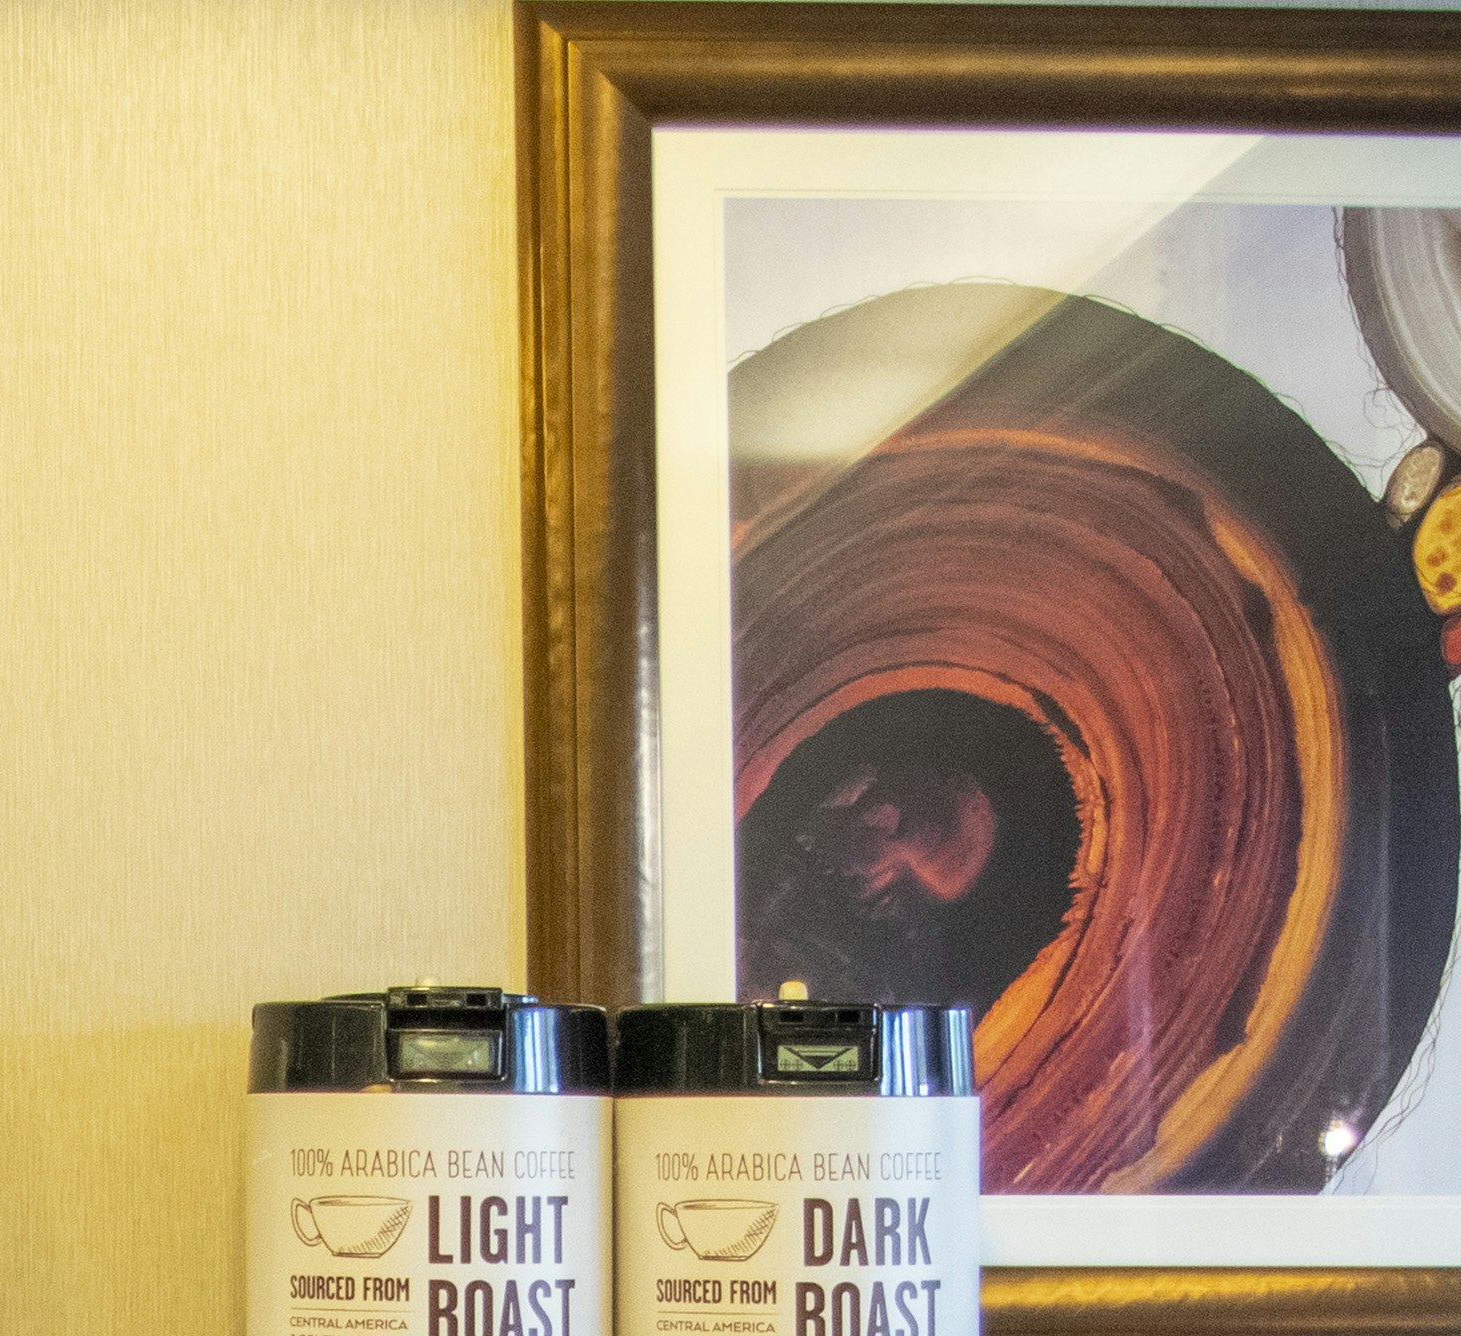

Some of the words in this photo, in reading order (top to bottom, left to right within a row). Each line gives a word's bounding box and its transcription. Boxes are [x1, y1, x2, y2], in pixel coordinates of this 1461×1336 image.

[290, 1149, 334, 1178] 100%
[340, 1150, 438, 1178] ARABICA
[447, 1151, 505, 1179] BEAN
[514, 1151, 576, 1179] COFFEE
[655, 1152, 699, 1181] 100%
[706, 1153, 803, 1181] ARABICA
[813, 1153, 871, 1181] BEAN
[880, 1152, 942, 1180] COFFEE
[428, 1195, 569, 1264] LIGHT
[803, 1197, 932, 1267] DARK
[290, 1275, 355, 1301] SOURCED
[363, 1277, 410, 1302] FROM
[656, 1279, 722, 1304] SOURCED
[729, 1280, 777, 1305] FROM
[289, 1316, 343, 1329] CENTRAL
[344, 1318, 408, 1331] AMERICA
[656, 1320, 709, 1333] CENTRAL
[711, 1322, 776, 1334] AMERICA
